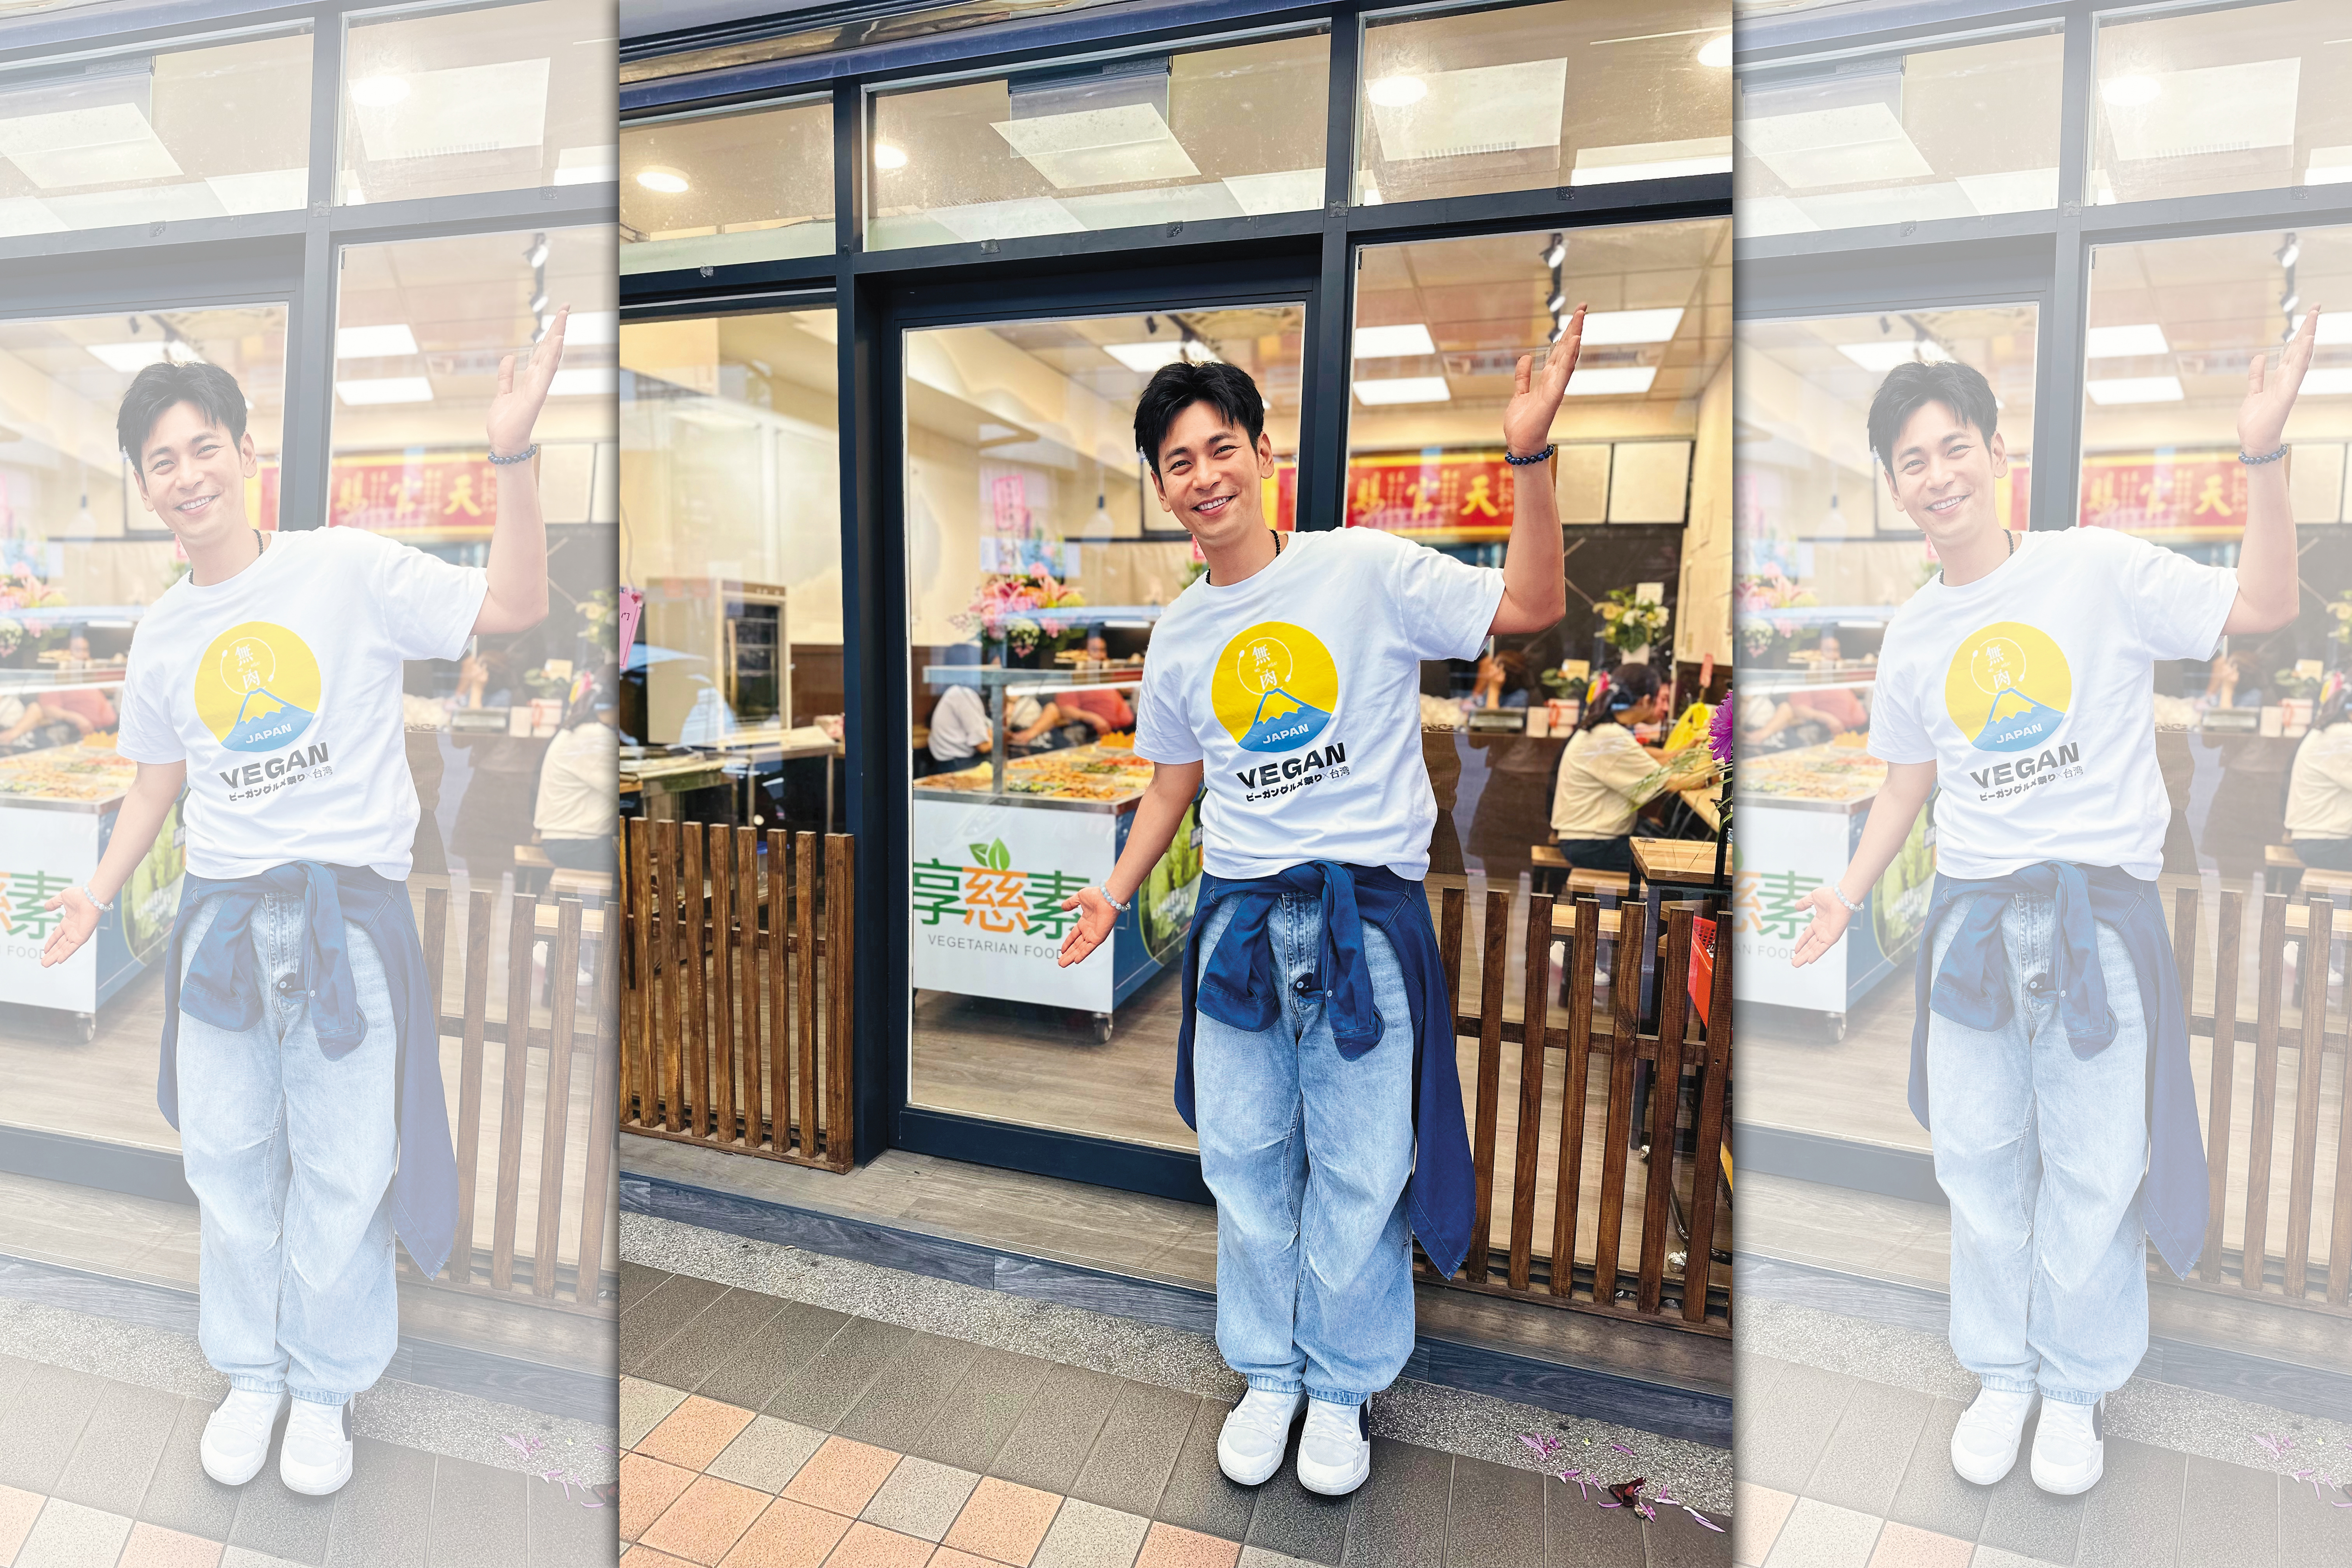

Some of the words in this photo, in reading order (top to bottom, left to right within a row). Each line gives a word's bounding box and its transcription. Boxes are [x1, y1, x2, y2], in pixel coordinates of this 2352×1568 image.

[246, 723, 293, 743] JAPAN
[1263, 724, 1309, 744] JAPAN
[1996, 723, 2043, 743] JAPAN
[220, 742, 329, 788] VEGAN
[1236, 742, 1346, 789] VEGAN
[1970, 742, 2080, 788] VEGAN
[0, 870, 72, 939] 素
[914, 858, 1090, 939] 享慈素
[928, 934, 1018, 955] VEGETARIAN
